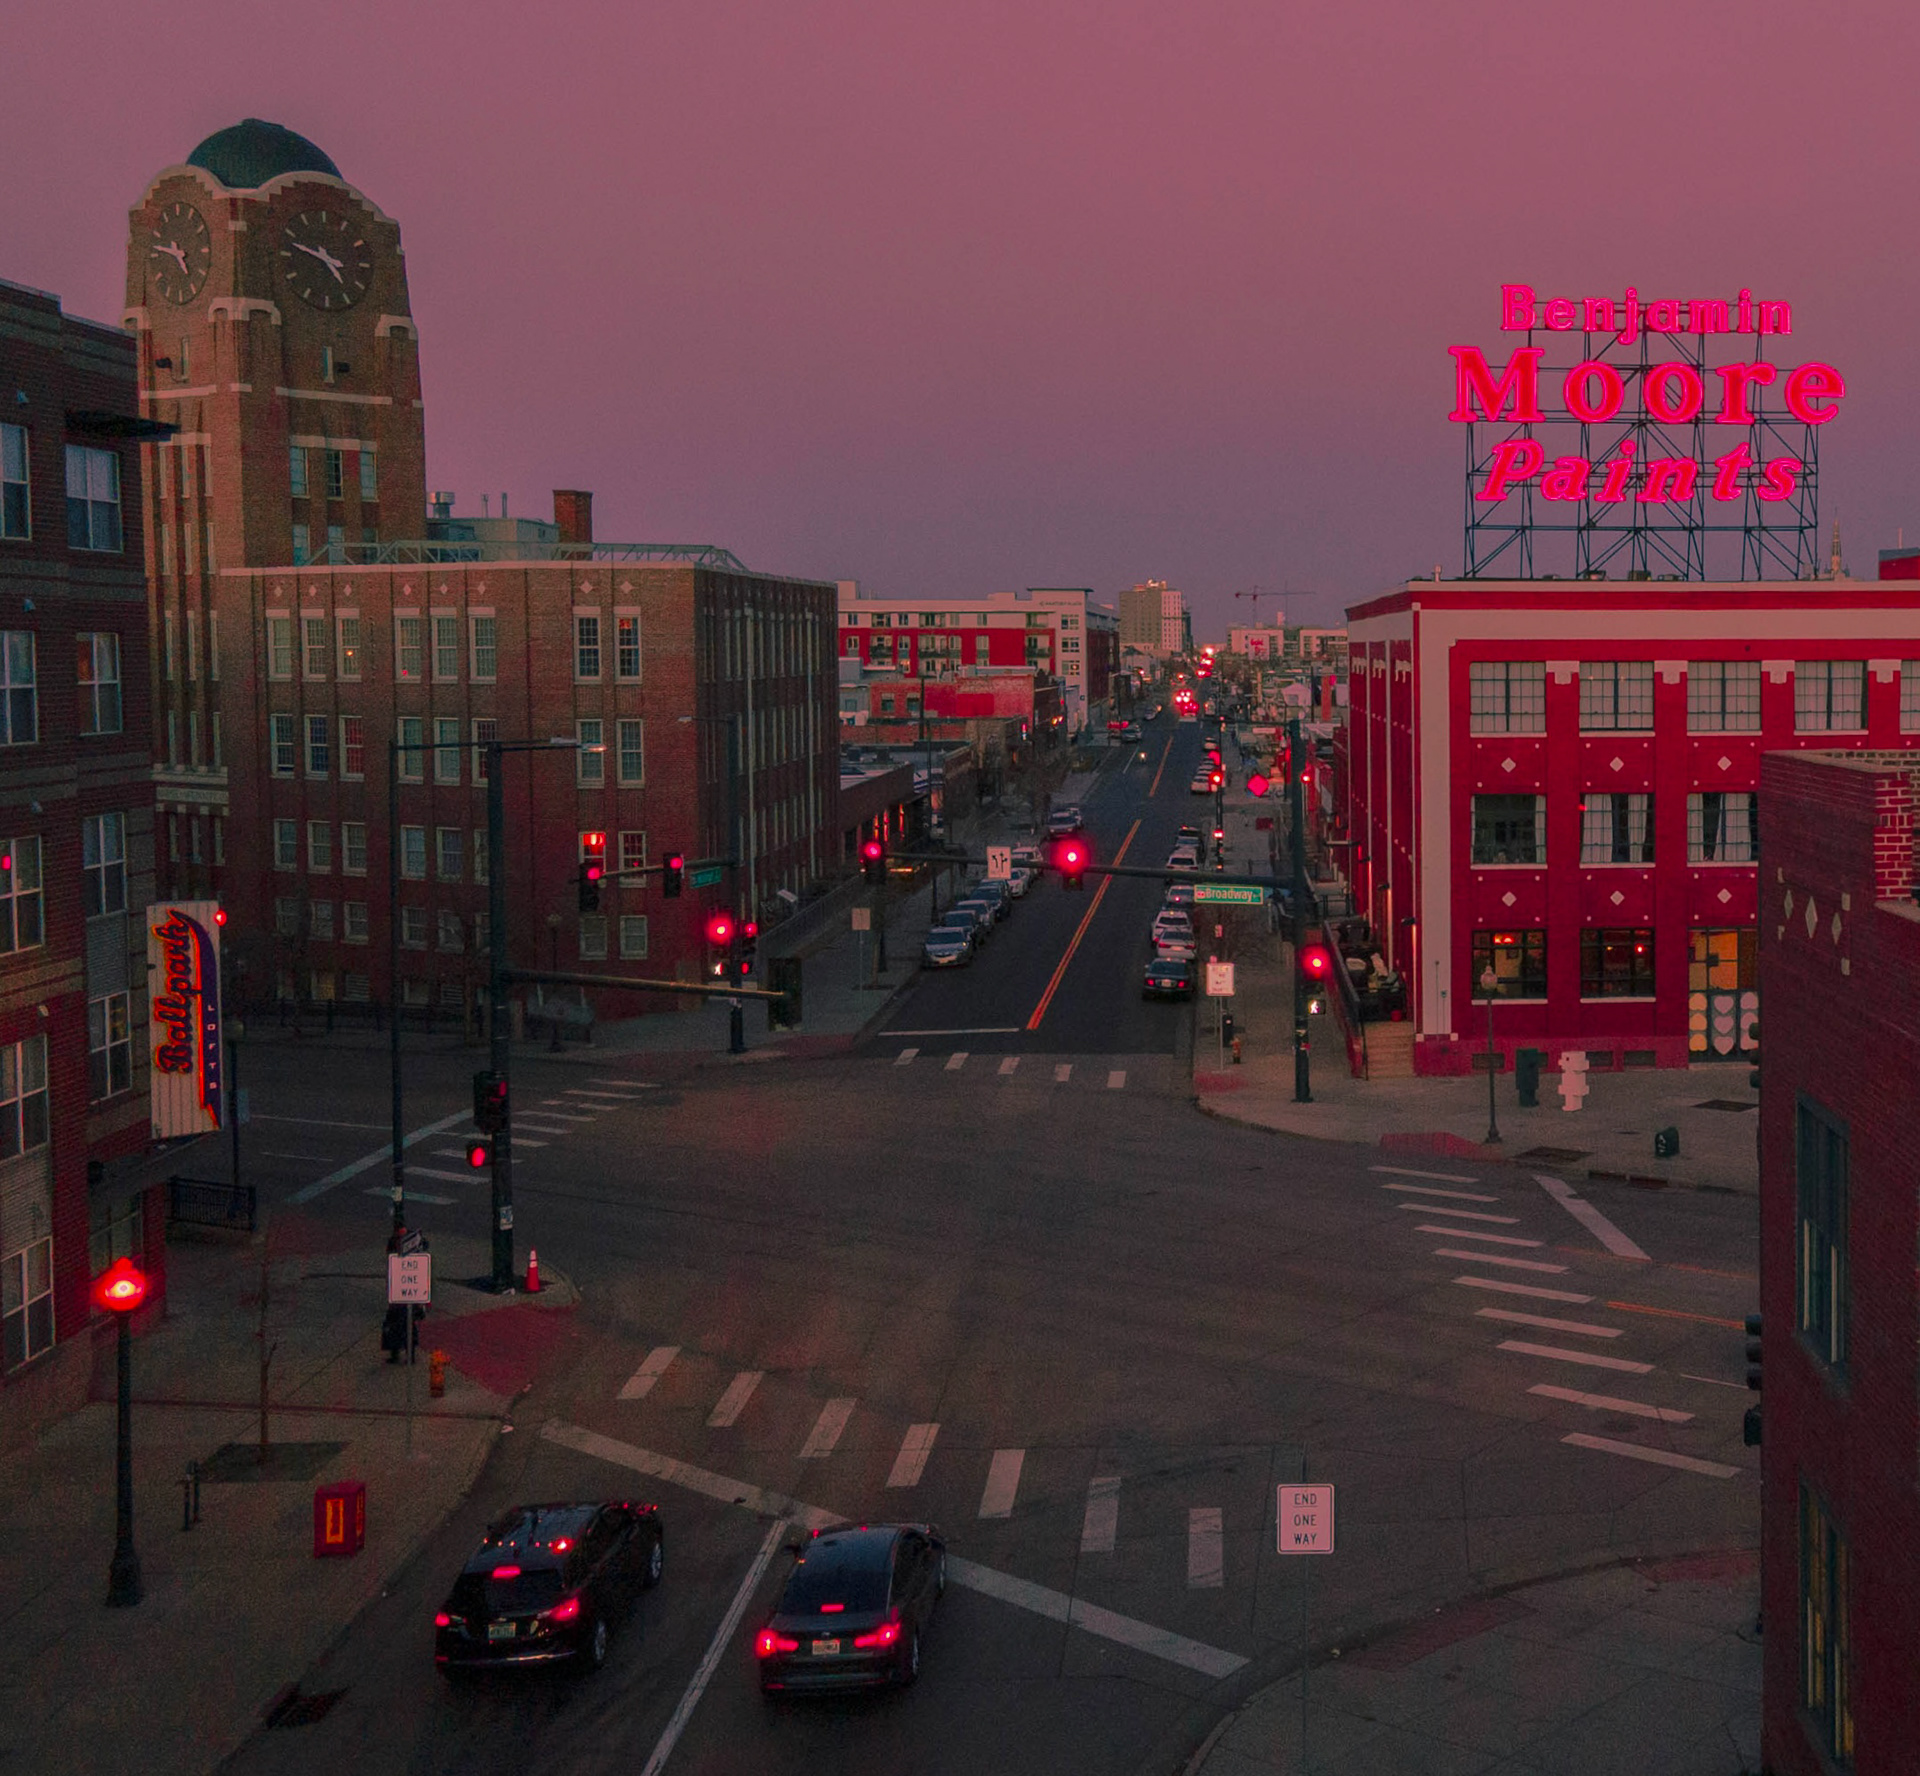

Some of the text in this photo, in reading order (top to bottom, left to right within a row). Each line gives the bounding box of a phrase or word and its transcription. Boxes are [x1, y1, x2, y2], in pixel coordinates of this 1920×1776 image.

[1501, 284, 1792, 345] Benjamin
[1448, 345, 1845, 425] Moore
[1475, 438, 1802, 503] Paints
[1205, 887, 1253, 903] Broadway
[152, 909, 200, 1075] Ballpark
[207, 1003, 218, 1090] LOFTS
[401, 1260, 418, 1270] END
[400, 1274, 418, 1285] ONE
[401, 1288, 418, 1298] WAY
[1294, 1493, 1317, 1505] END
[1293, 1514, 1317, 1527] ONE
[1294, 1533, 1317, 1545] WAY
